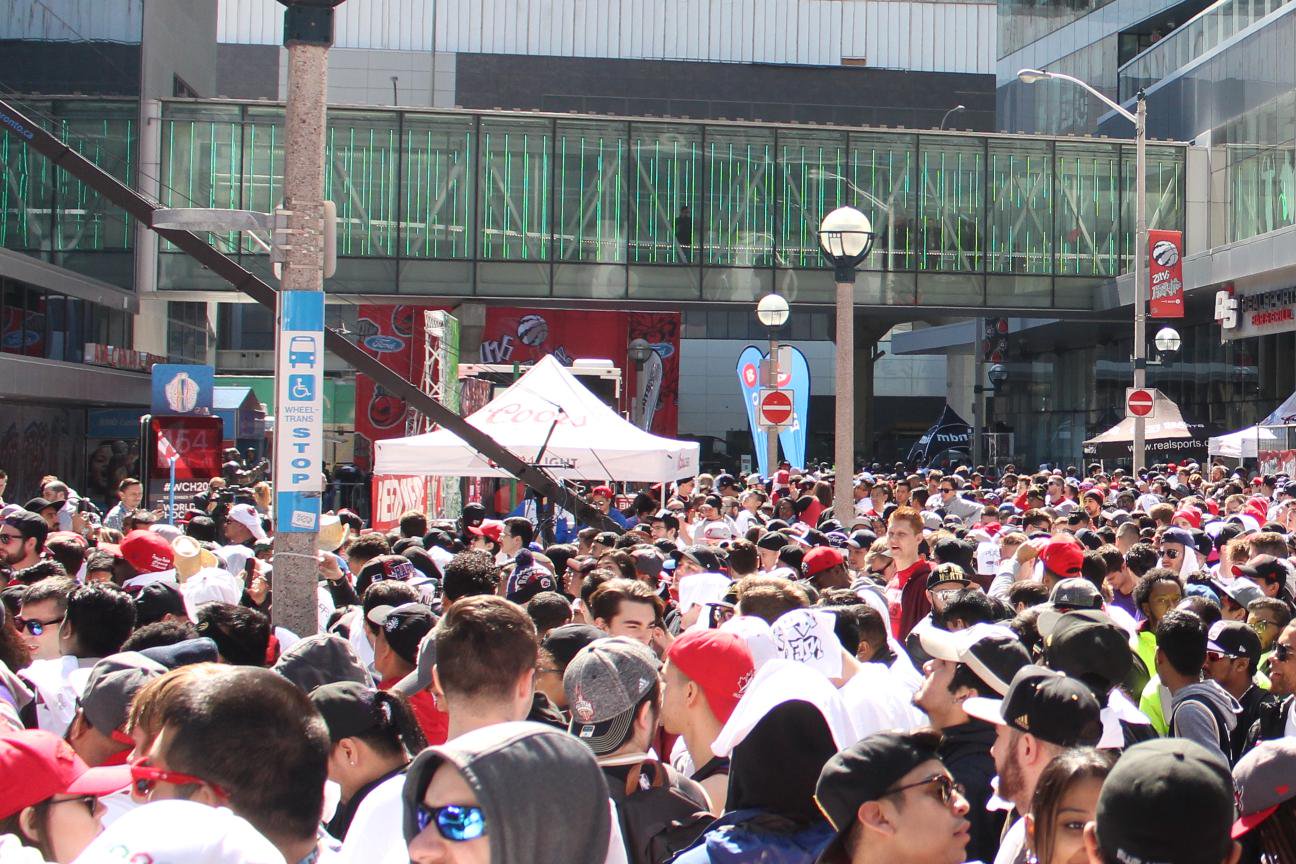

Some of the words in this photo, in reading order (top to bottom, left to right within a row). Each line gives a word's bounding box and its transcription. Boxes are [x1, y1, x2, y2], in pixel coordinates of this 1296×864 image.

[285, 406, 319, 414] WHEEL-
[285, 415, 314, 423] TRANS
[291, 427, 311, 485] STOP
